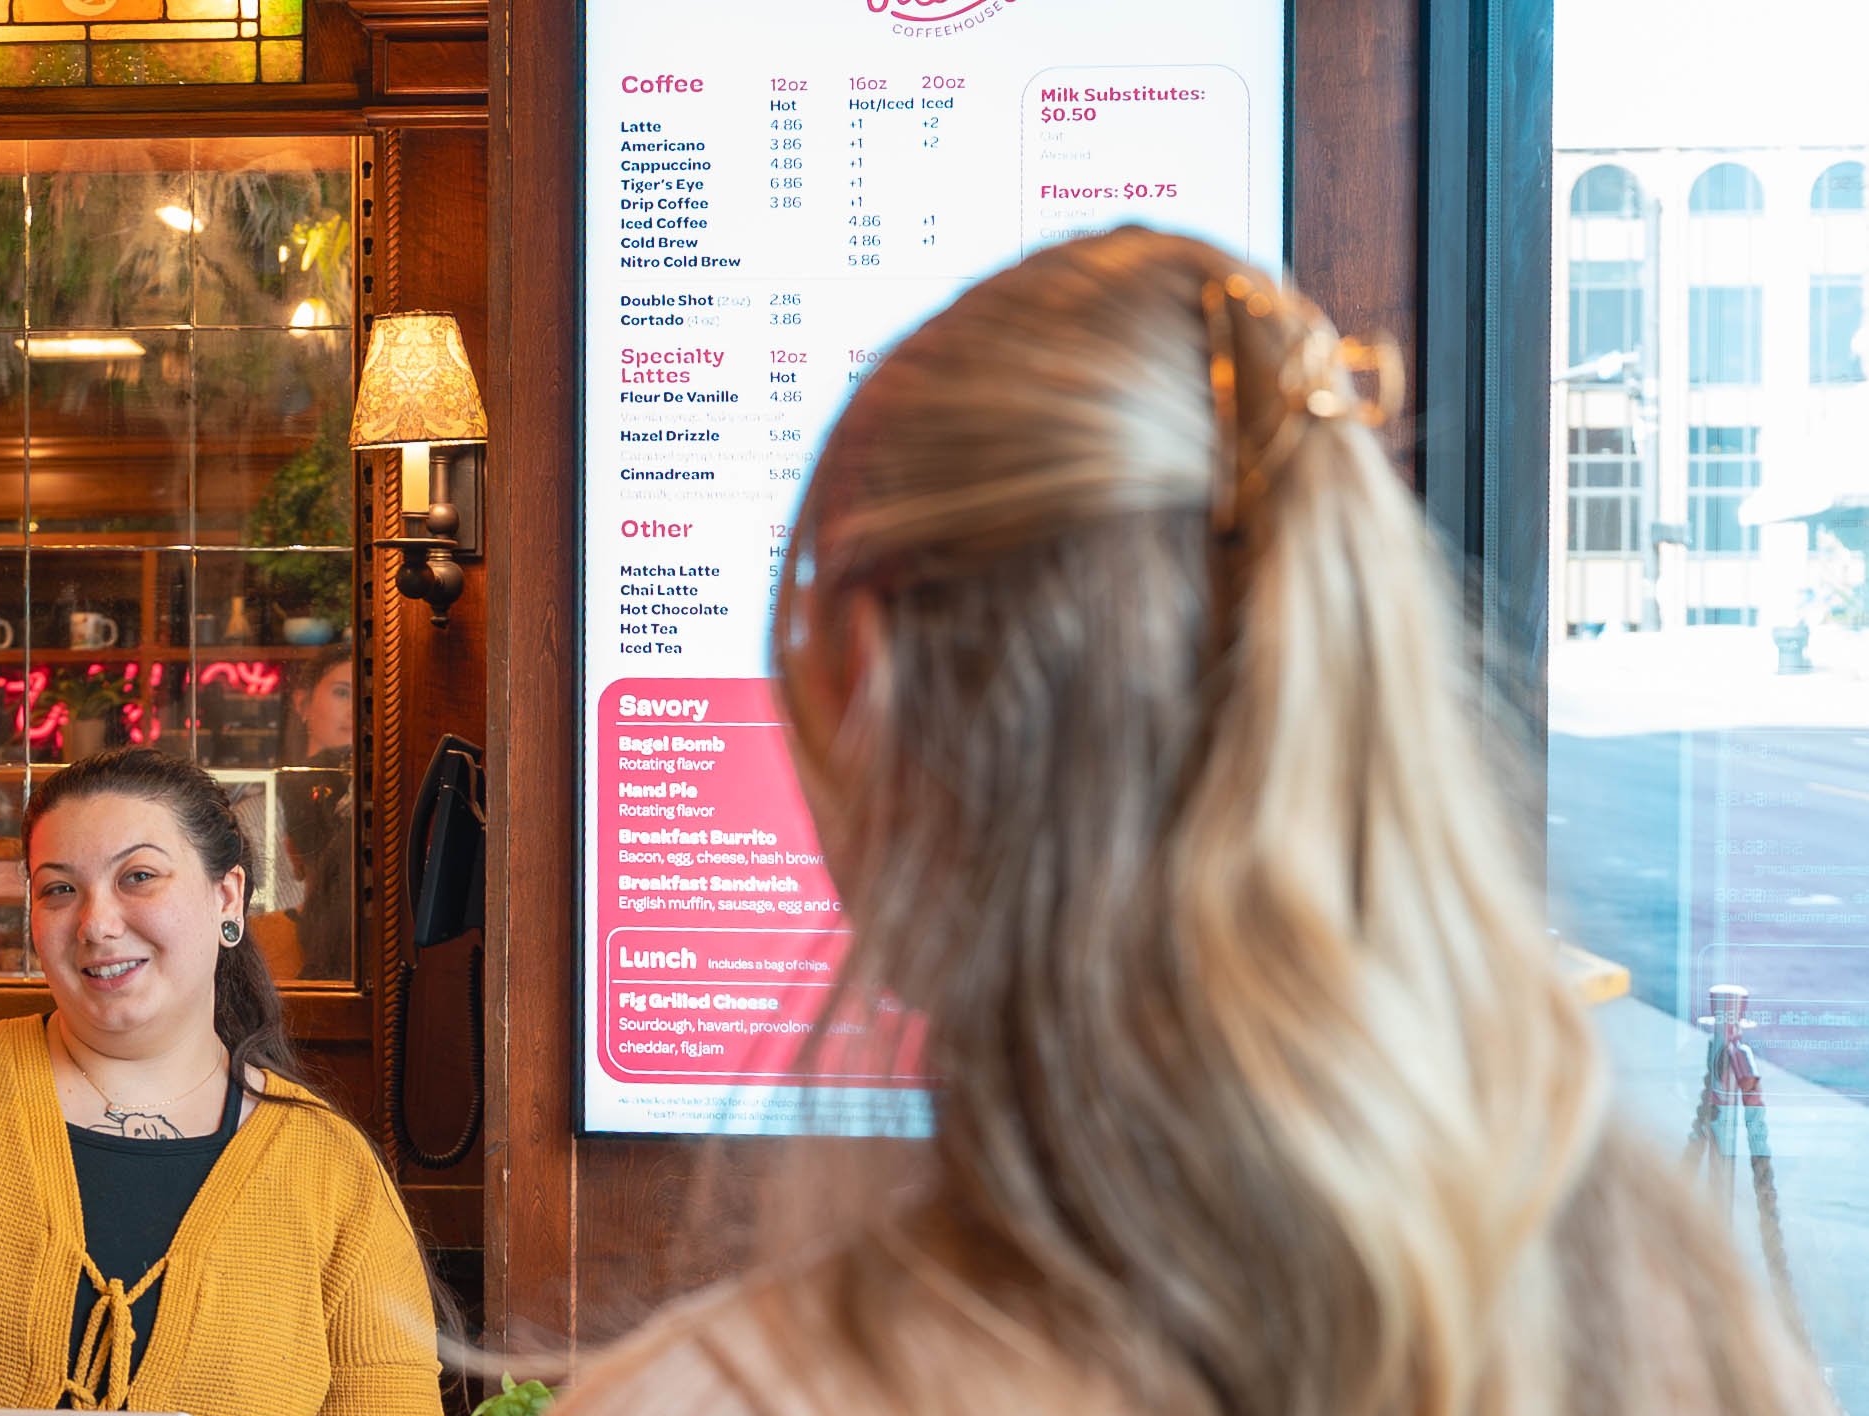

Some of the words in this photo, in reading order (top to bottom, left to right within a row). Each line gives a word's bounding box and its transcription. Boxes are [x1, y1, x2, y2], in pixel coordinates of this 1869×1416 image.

[892, 0, 1003, 38] COFFEEHOUSE
[621, 75, 704, 94] Coffee
[770, 78, 808, 92] 12oz
[849, 77, 887, 90] 16oz
[922, 76, 965, 89] 20oz
[1041, 87, 1080, 103] Milk
[1084, 86, 1206, 102] Substitutes:
[770, 100, 797, 111] Hot
[849, 98, 914, 112] Hot/Iced
[922, 98, 954, 110] Iced
[1040, 106, 1097, 123] $0.50
[620, 121, 662, 133] Latte
[770, 118, 803, 131] 4.86
[620, 140, 705, 152] Americano
[770, 138, 802, 151] 3.86
[620, 159, 711, 173] Cappuccino
[770, 158, 803, 171] 4.86
[620, 178, 673, 193] Tiger's
[676, 178, 704, 192] Eye
[1041, 185, 1118, 199] Flavors:
[1123, 183, 1178, 200] $0.75
[620, 198, 654, 213] Drip
[658, 198, 709, 210] Coffee
[770, 197, 802, 209] 3.86
[620, 218, 652, 230] Iced
[657, 217, 708, 230] Coffee
[849, 215, 881, 227] 4.86
[620, 237, 655, 249] Cold
[659, 237, 698, 249] Brew
[849, 235, 881, 247] 4.86
[620, 256, 660, 268] Nitro
[663, 256, 697, 268] Cold
[701, 257, 741, 268] Brew
[848, 254, 880, 267] 5.86
[620, 294, 675, 307] Double
[678, 294, 714, 307] Shot
[769, 294, 801, 306] 2.86
[620, 314, 684, 326] Cortado
[769, 314, 802, 326] 3.86
[620, 348, 724, 368] Specialty
[770, 350, 808, 364] 12oz
[849, 350, 882, 364] 16o
[621, 368, 690, 384] Lattes
[770, 372, 797, 384] Hot
[620, 392, 661, 404] Fleur
[663, 392, 684, 404] De
[687, 391, 739, 404] Vanille
[770, 391, 802, 403] 4.86
[620, 430, 663, 442] Hazel
[666, 430, 720, 442] Drizzle
[769, 430, 801, 442] 5.86
[620, 468, 715, 481] Cinnadream
[769, 469, 801, 481] 5.86
[621, 519, 693, 538] Other
[620, 565, 676, 577] Matcha
[679, 566, 720, 577] Latte
[620, 584, 654, 596] Chai
[658, 585, 698, 596] Latte
[620, 604, 648, 615] Hot
[651, 604, 728, 615] Chocolate
[620, 623, 648, 635] Hot
[651, 624, 678, 635] Tea
[620, 642, 652, 654] Iced
[655, 643, 682, 654] Tea
[619, 695, 709, 721] Savory
[618, 736, 669, 755] Bagel
[672, 736, 725, 752] Bomb
[619, 757, 675, 773] Rotating
[677, 757, 715, 771] flavor
[618, 782, 667, 798] Hand
[669, 781, 698, 799] Pie
[619, 803, 675, 820] Rotating
[677, 803, 715, 817] flavor
[618, 828, 708, 845] Breakfast
[710, 829, 777, 845] Burrito
[619, 850, 665, 865] Bacon,
[667, 853, 694, 867] egg,
[696, 850, 749, 865] cheese,
[751, 851, 783, 865] hash
[618, 875, 708, 891] Breakfast
[710, 875, 798, 892] Sandwich
[619, 896, 666, 912] English
[668, 897, 715, 912] muffin,
[718, 900, 776, 914] sausage,
[778, 901, 803, 915] egg
[804, 899, 830, 912] and
[619, 946, 697, 969] Lunch
[708, 958, 754, 971] Includes
[755, 962, 763, 971] a
[764, 959, 785, 973] bag
[786, 959, 799, 971] of
[799, 959, 831, 973] chips.
[619, 992, 647, 1012] Fig
[649, 993, 711, 1010] Grilled
[713, 993, 779, 1010] Cheese
[619, 1017, 695, 1034] Sourdough,
[697, 1018, 748, 1034] havarti,
[619, 1040, 678, 1056] cheddar,
